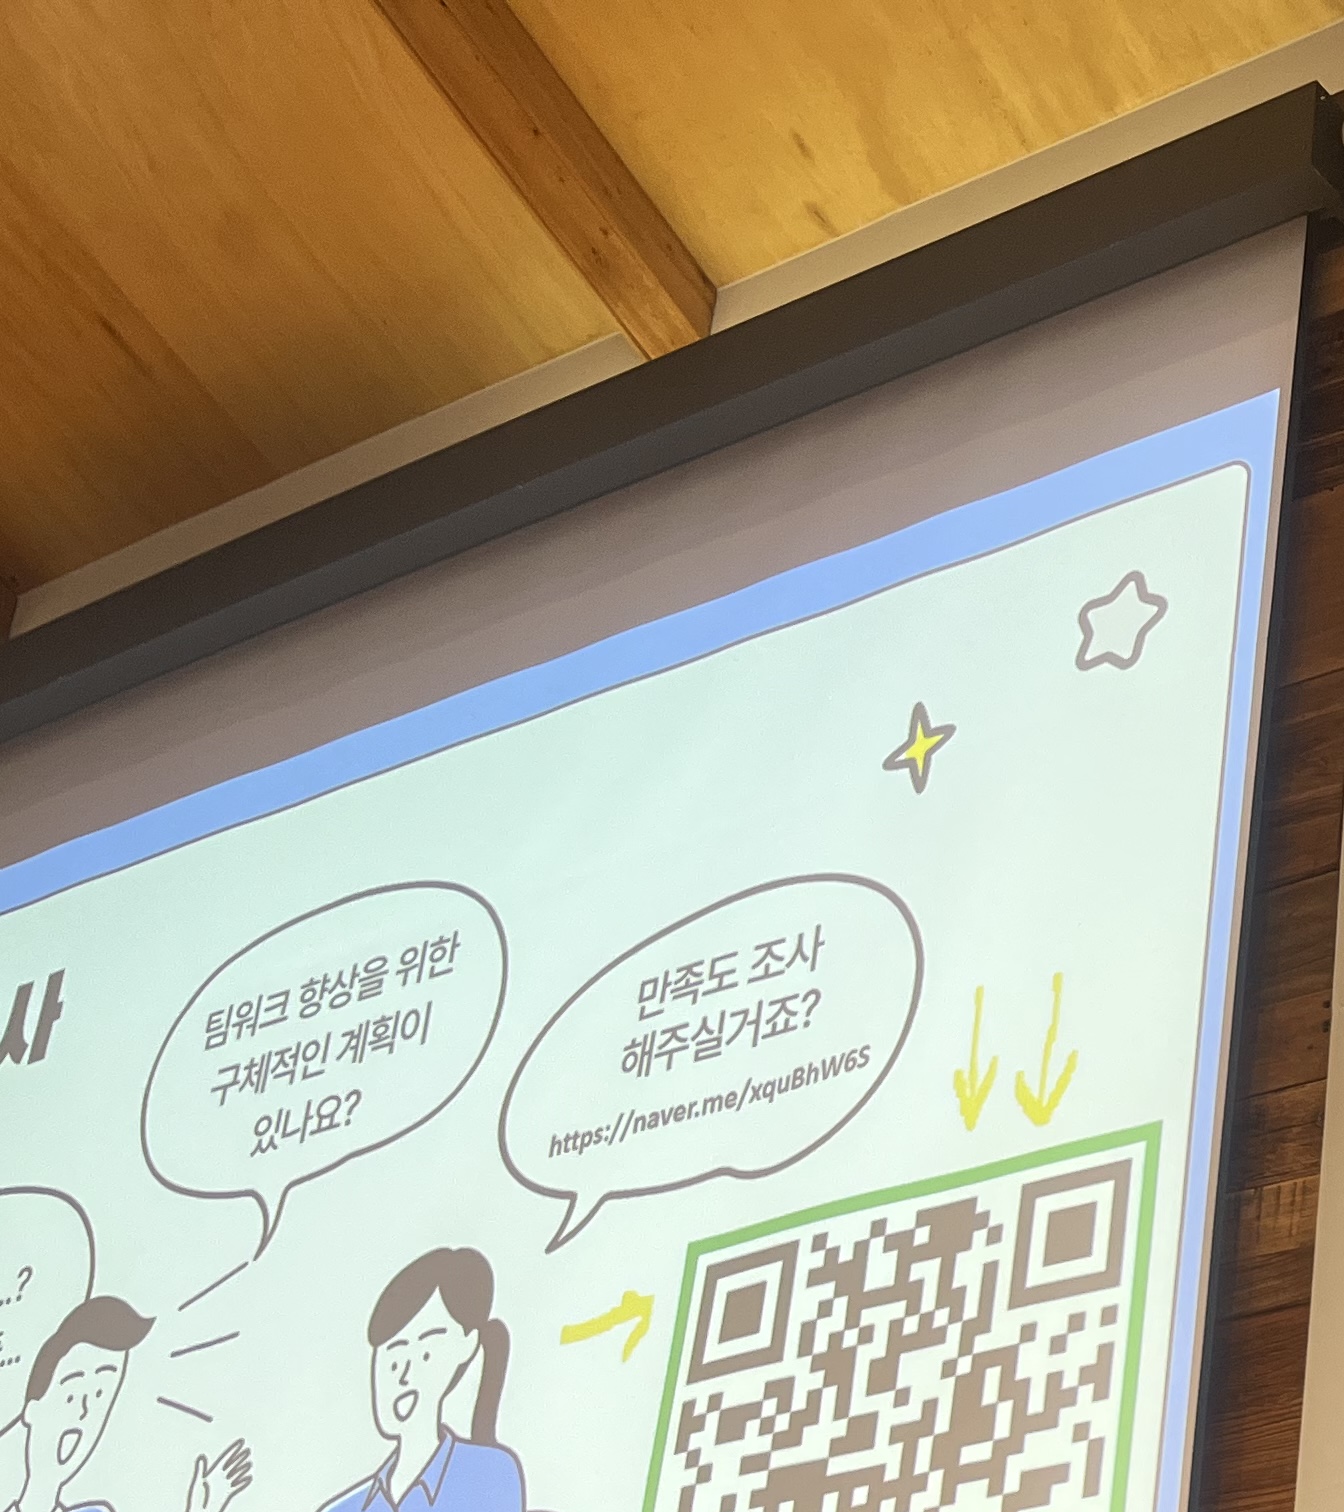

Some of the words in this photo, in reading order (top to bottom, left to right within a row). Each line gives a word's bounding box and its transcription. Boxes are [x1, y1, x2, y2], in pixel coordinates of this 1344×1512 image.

[205, 987, 290, 1052] 팀워크
[298, 955, 390, 1019] 향상을
[396, 931, 461, 990] 위한
[636, 951, 740, 1021] 만족도
[747, 923, 826, 985] 조사
[211, 1033, 334, 1106] 구체적인
[336, 1001, 433, 1066] 계획이
[620, 987, 822, 1080] 해주실거죠?
[250, 1087, 364, 1158] 있나요?
